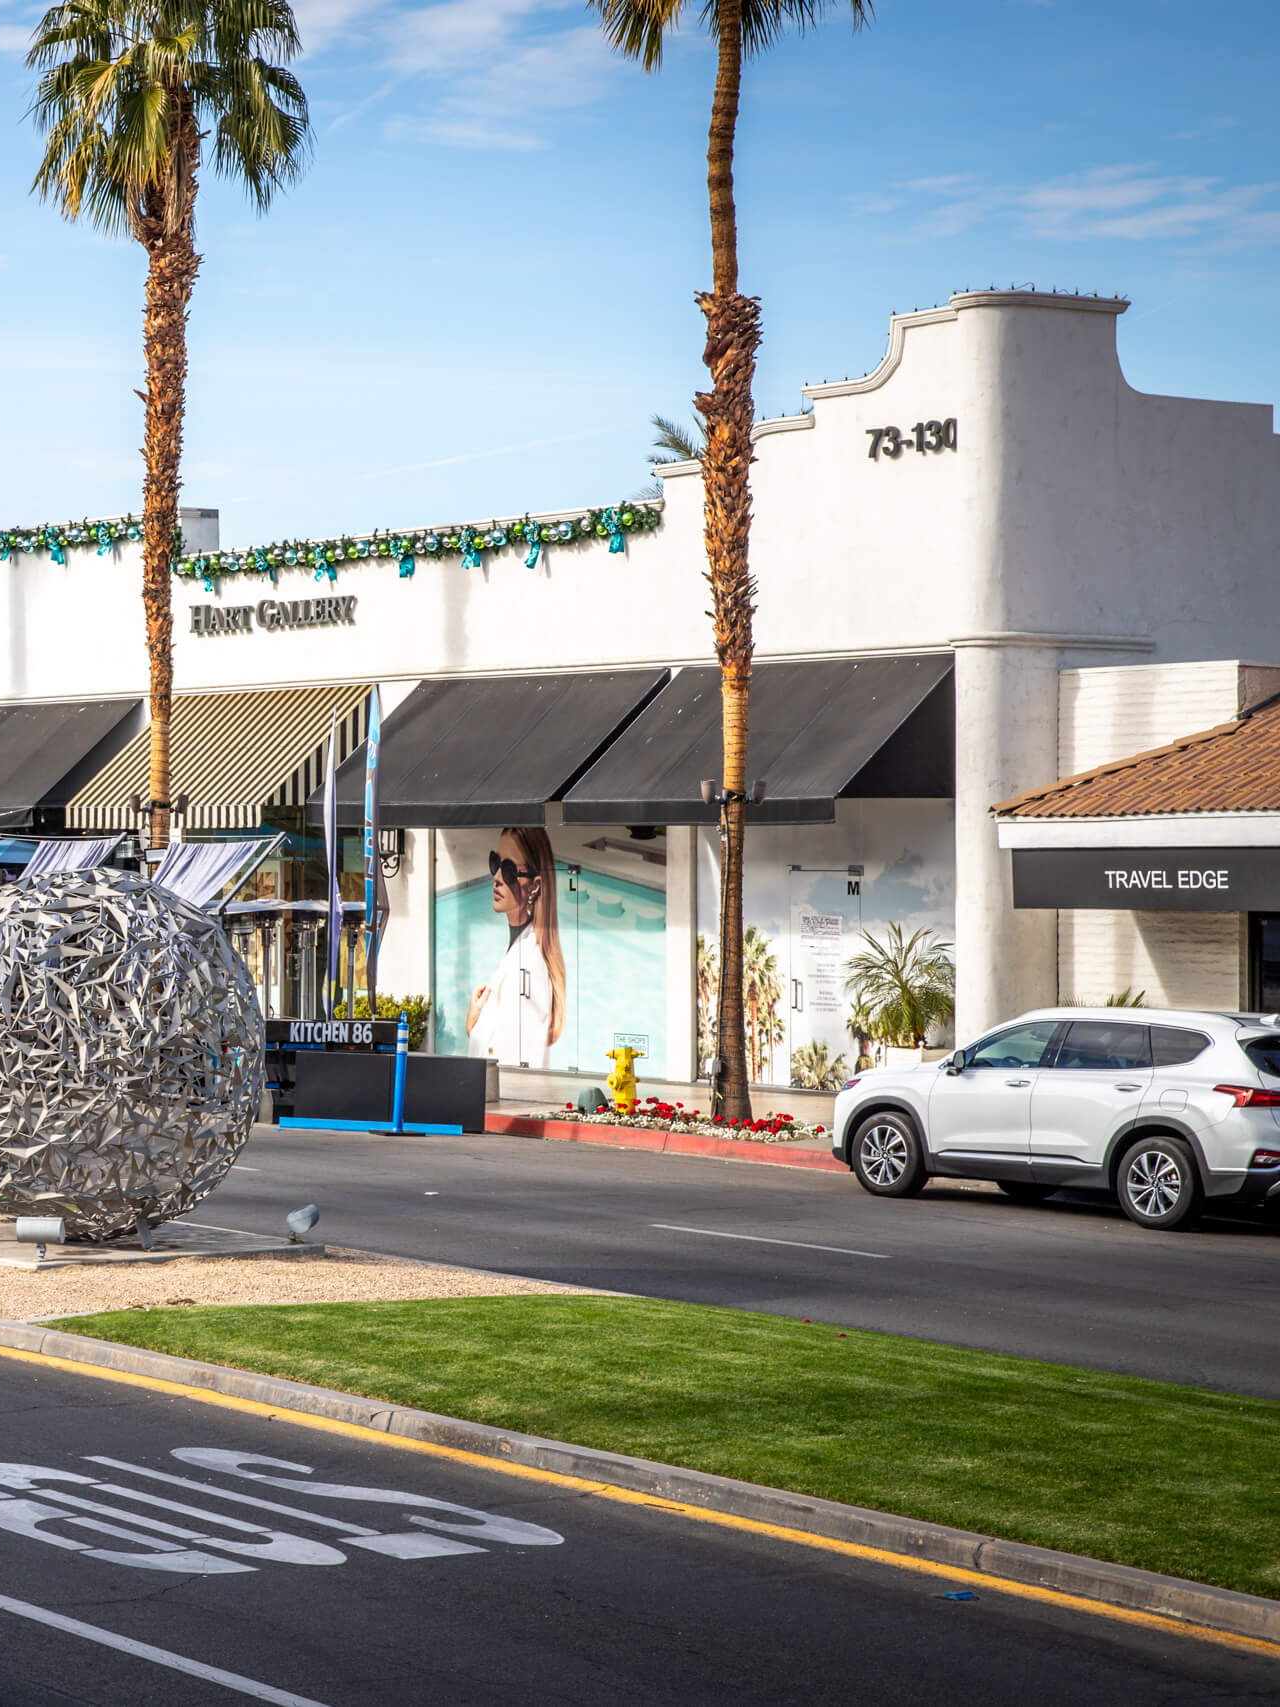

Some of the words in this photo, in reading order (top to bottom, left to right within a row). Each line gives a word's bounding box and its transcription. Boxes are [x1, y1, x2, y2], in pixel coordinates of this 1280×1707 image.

[865, 418, 958, 461] 73-130
[189, 604, 254, 638] HART
[255, 595, 358, 633] GALLERY
[568, 878, 577, 892] L
[846, 880, 861, 896] M
[1103, 870, 1173, 889] TRAVEL
[1177, 870, 1229, 889] EDGE
[289, 1021, 350, 1044] KITCHEN
[351, 1023, 374, 1045] 86
